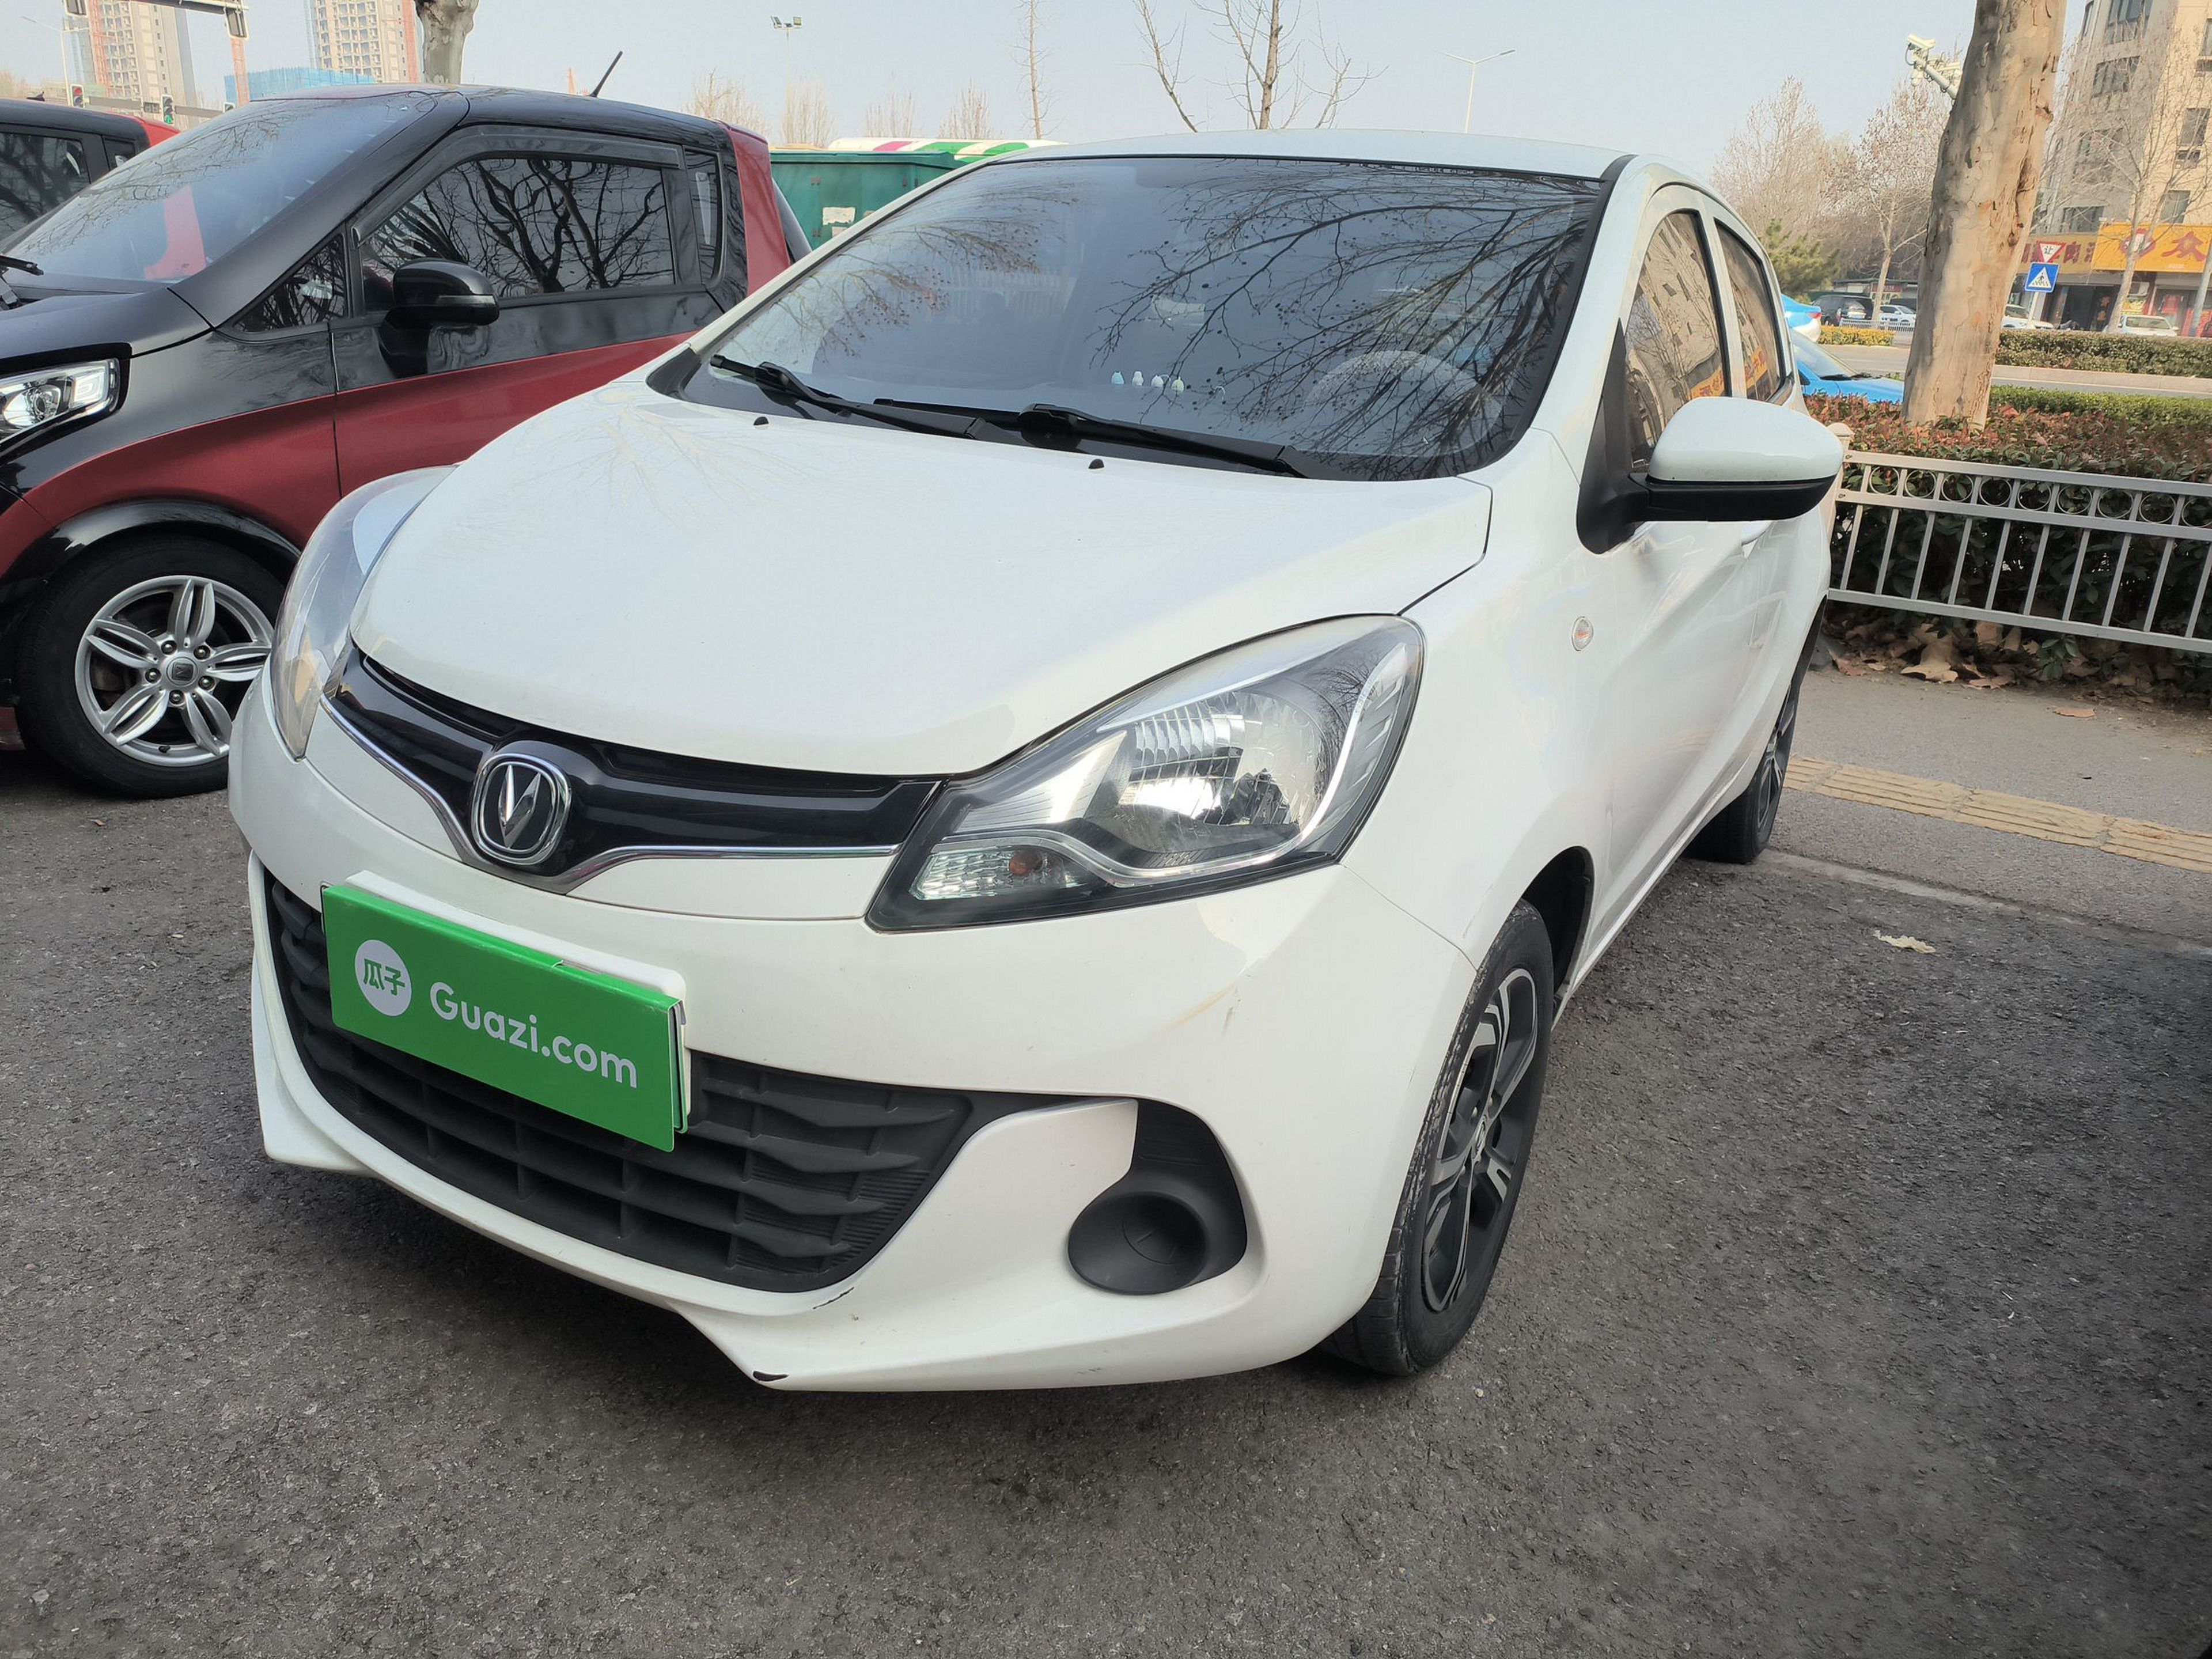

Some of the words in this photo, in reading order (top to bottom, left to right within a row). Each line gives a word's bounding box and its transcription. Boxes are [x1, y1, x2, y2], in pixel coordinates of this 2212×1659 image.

[2044, 245, 2054, 255] 让
[363, 958, 405, 996] 瓜子
[430, 982, 637, 1089] Guazi.com
